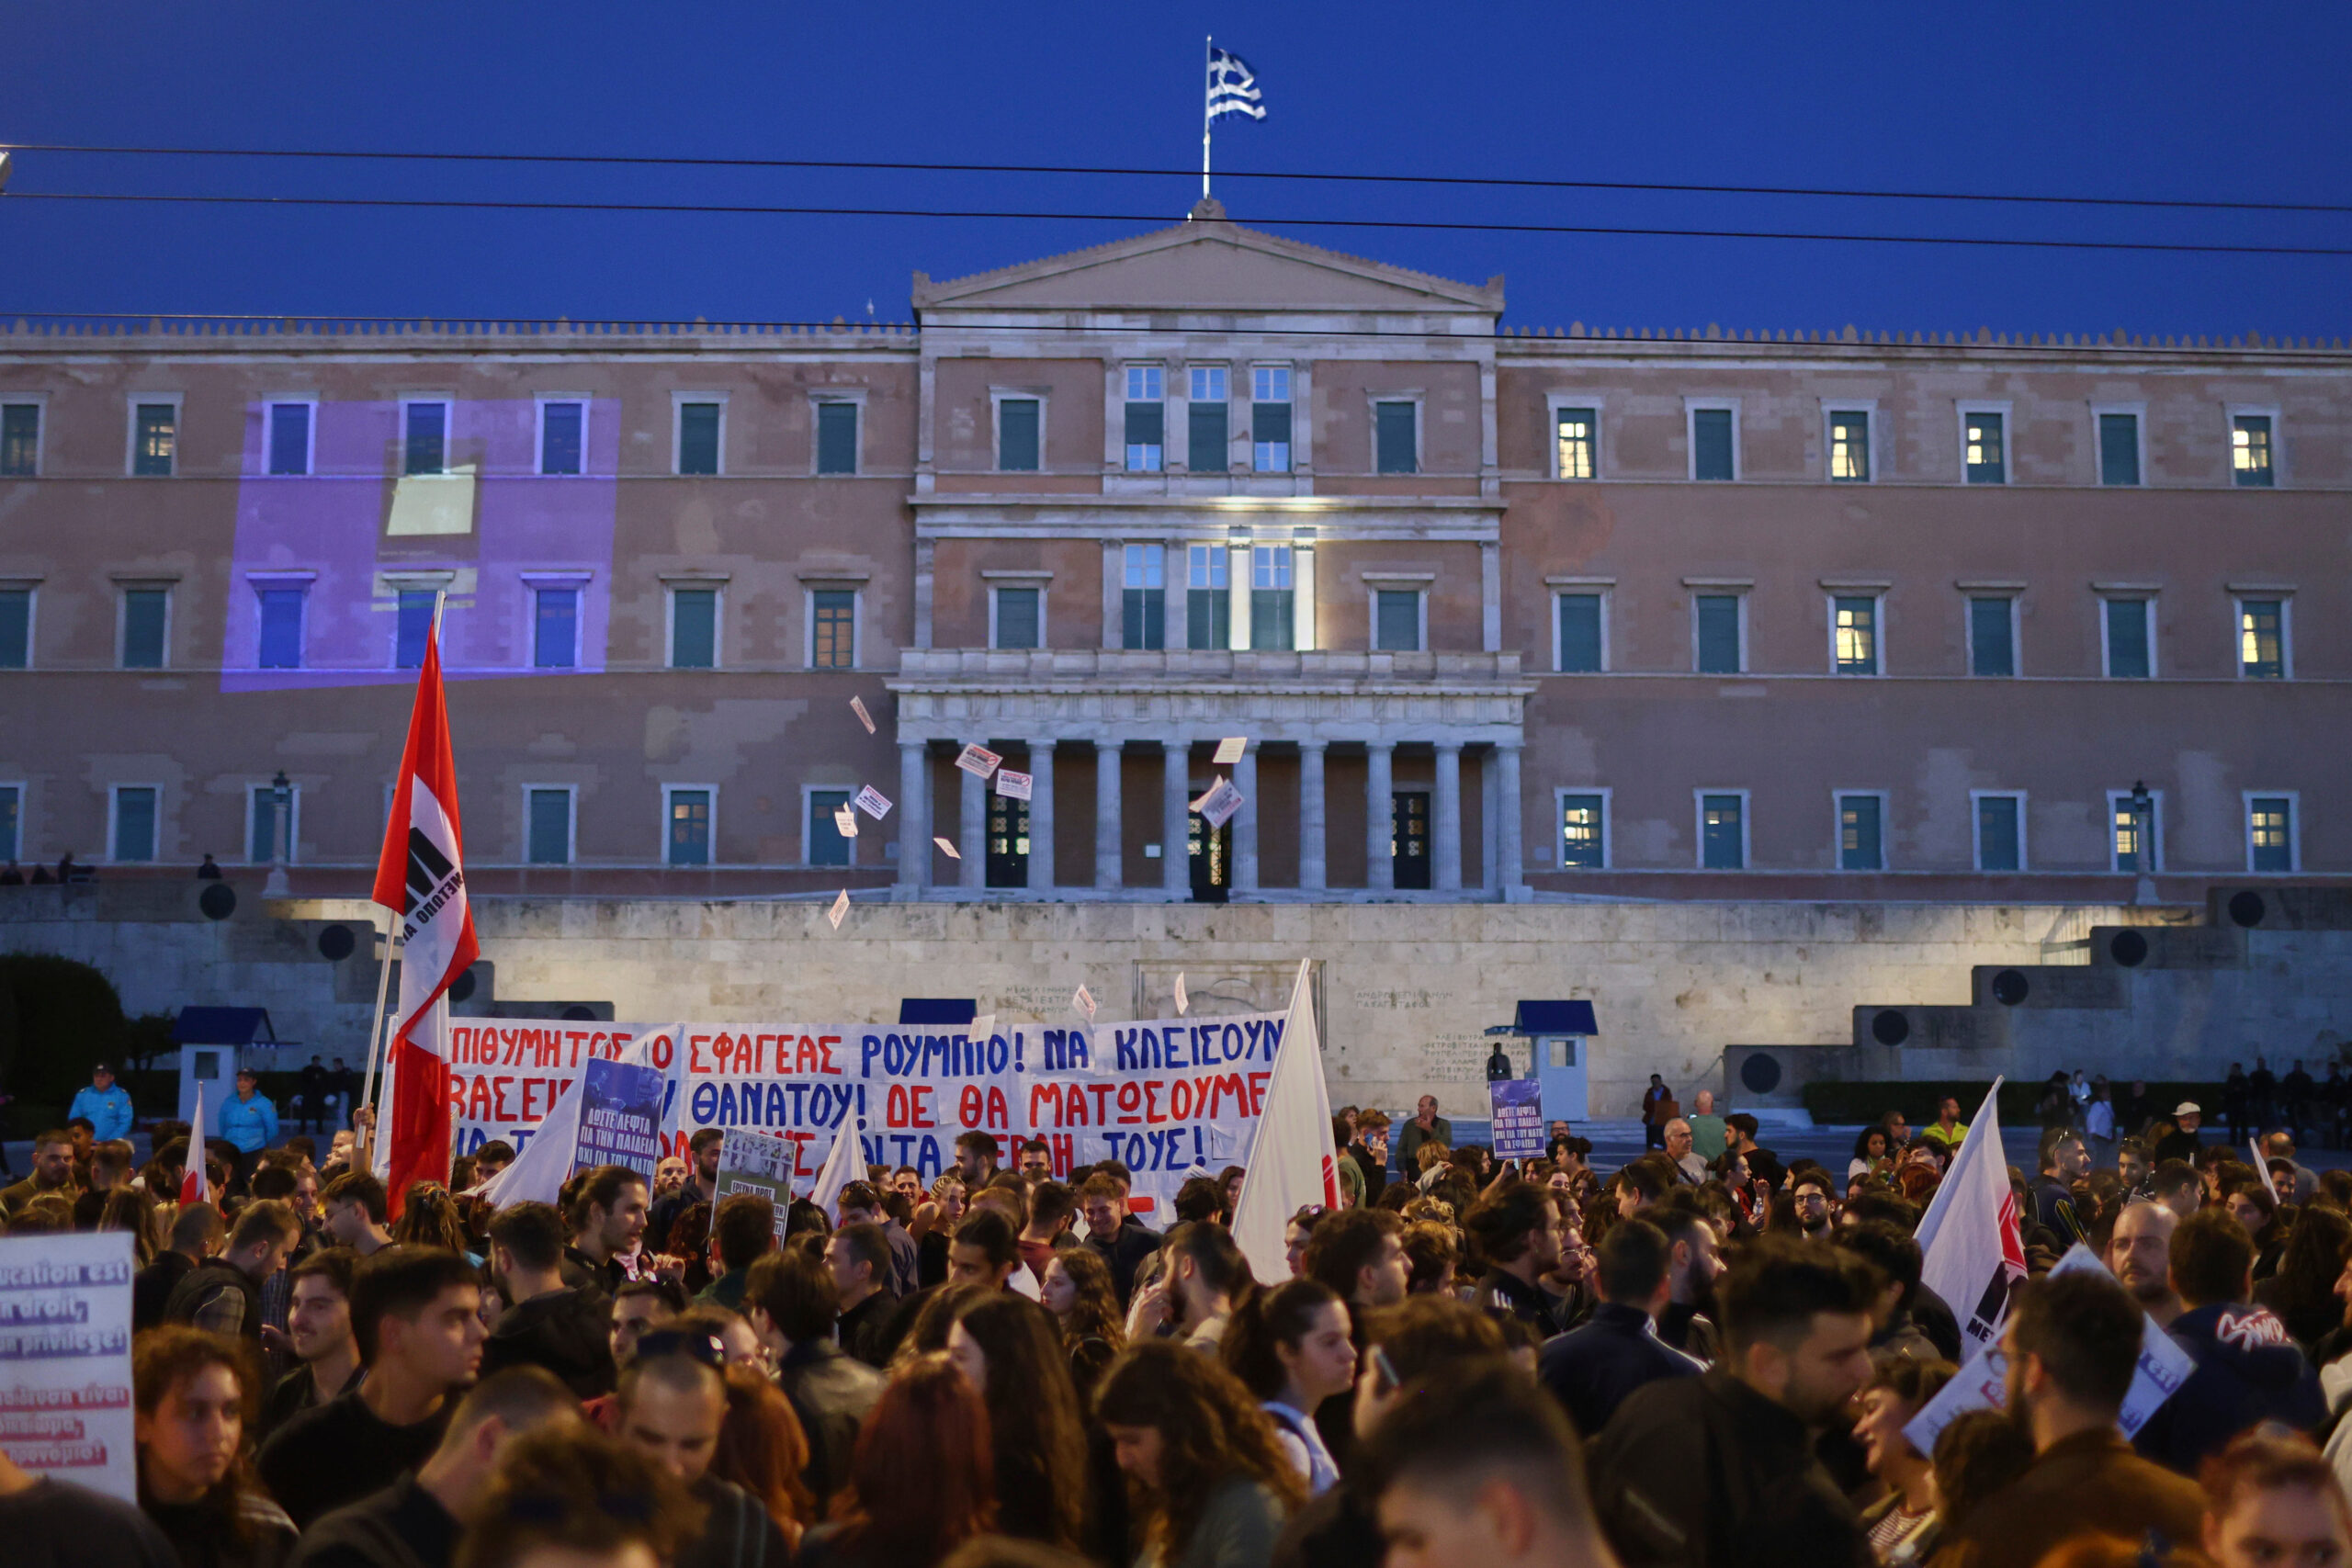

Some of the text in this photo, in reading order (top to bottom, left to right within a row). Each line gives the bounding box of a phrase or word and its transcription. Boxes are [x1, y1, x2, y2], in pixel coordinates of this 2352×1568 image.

[690, 1032, 842, 1075] ΣΦΑΓΕΑΣ
[862, 1032, 1025, 1078] ΡΟΥΜΠΙΟ!
[1043, 1029, 1090, 1071] ΝΑ
[1114, 1019, 1285, 1070] ΚΛΕΙΣΟΥΝ
[692, 1082, 866, 1132] ΘΑΝΑΤΟΥ!
[887, 1084, 935, 1129] ΔΕ
[959, 1084, 1009, 1129] ΘΑ
[1030, 1072, 1272, 1129] ΜΑΤΩΣΟΥΜΕ
[588, 1108, 650, 1135] ΔΩΣΤΕ ΛΕΦΤΑ
[580, 1125, 594, 1145] ΓΙΑ
[595, 1129, 615, 1149] ΤΗΝ
[616, 1133, 654, 1156] ΠΑΙΔΕΙΑ
[1102, 1125, 1206, 1172] ΤΟΥΣ!
[577, 1146, 654, 1177] ΟΧΙ ΓΙΑ ΤΟΥ ΝΑΤΟ
[88, 1260, 127, 1281] est
[19, 1295, 85, 1322] droit,
